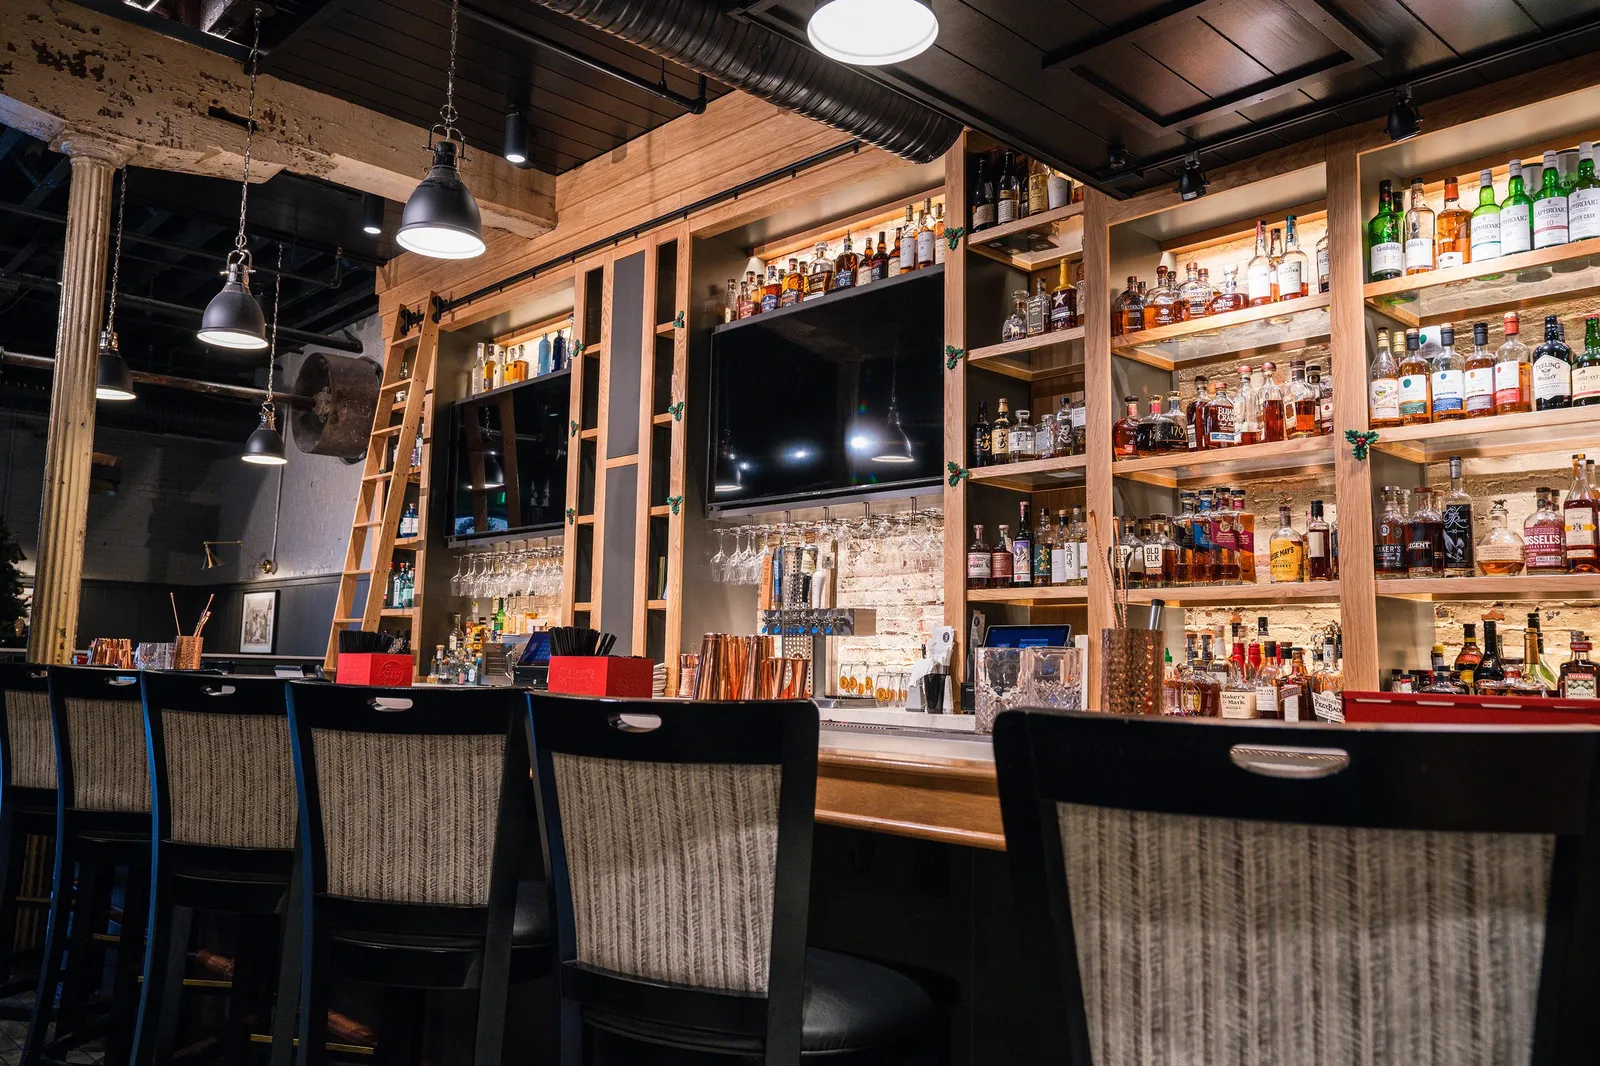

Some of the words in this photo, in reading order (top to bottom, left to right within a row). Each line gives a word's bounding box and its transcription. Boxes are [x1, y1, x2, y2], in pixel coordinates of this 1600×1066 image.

[1535, 362, 1561, 372] TEELING
[1146, 547, 1160, 555] OLD
[1146, 554, 1160, 562] ELK
